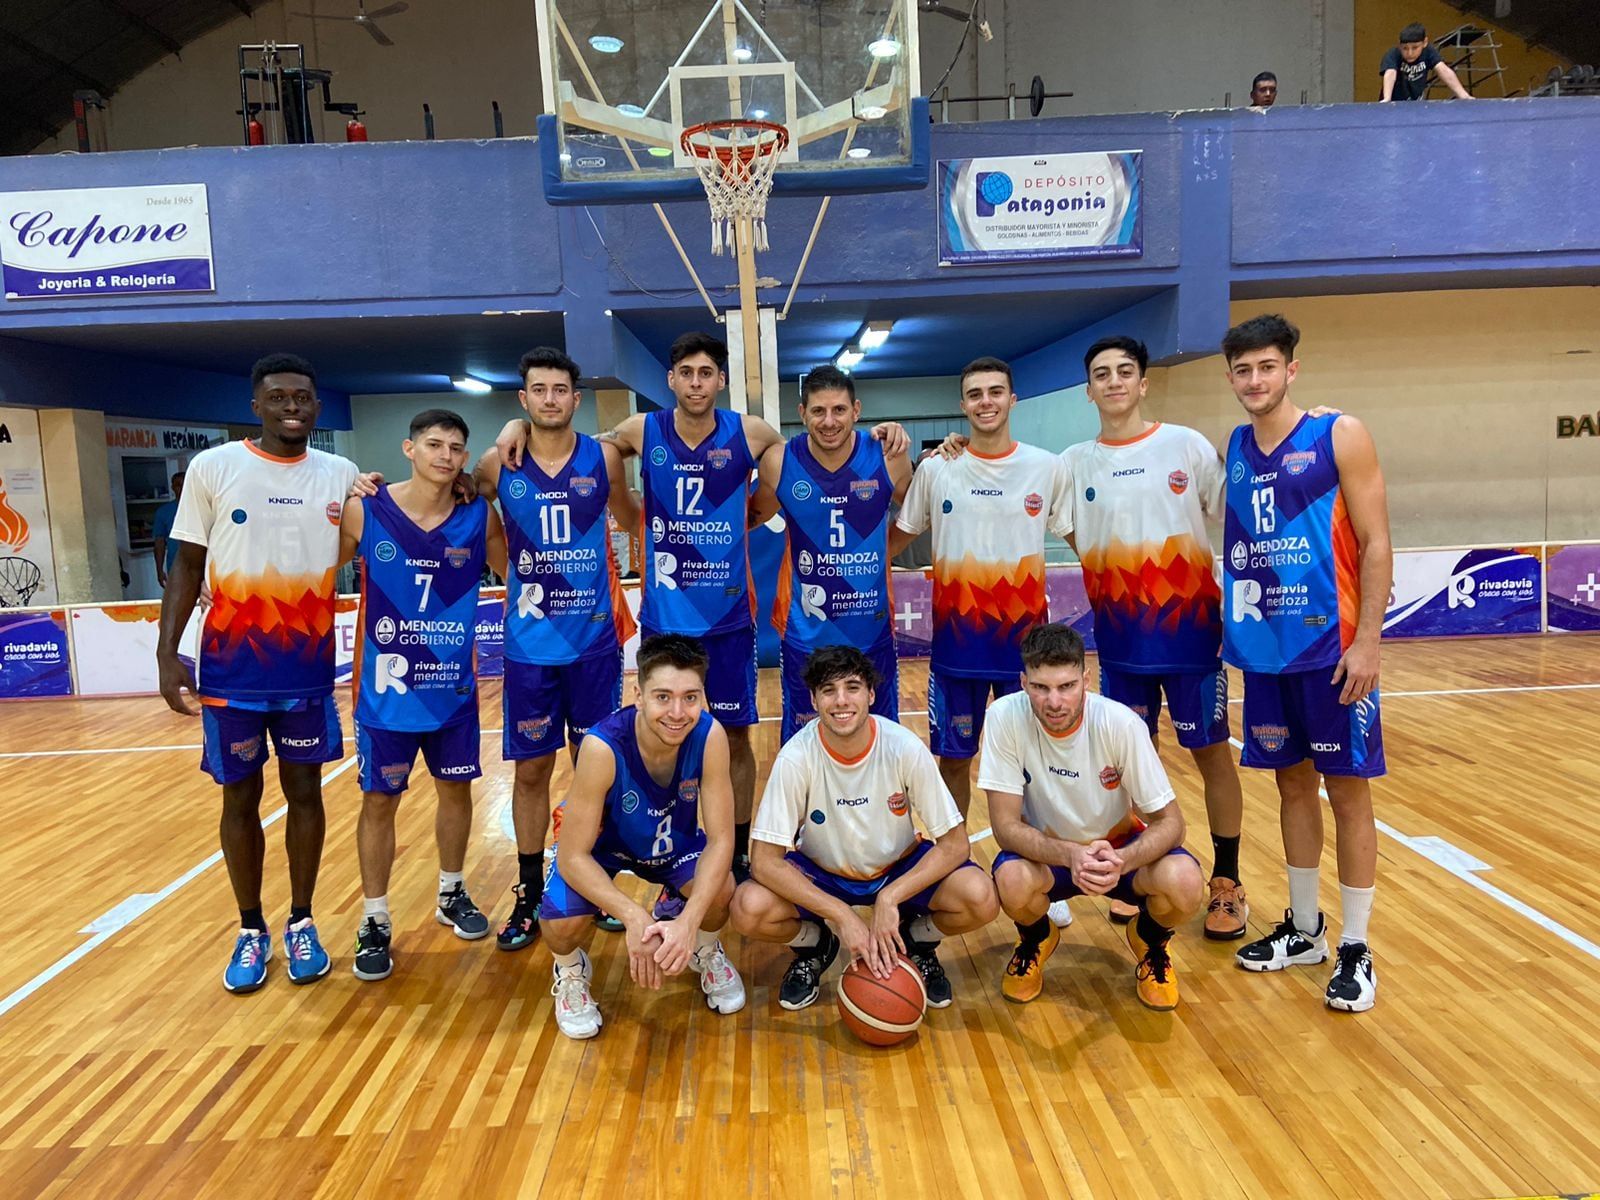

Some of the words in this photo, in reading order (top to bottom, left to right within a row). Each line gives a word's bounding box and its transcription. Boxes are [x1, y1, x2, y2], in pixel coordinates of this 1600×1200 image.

[1024, 175, 1105, 188] DEPÓSITO
[146, 197, 171, 206] Desde
[173, 196, 194, 205] 1965
[985, 224, 1026, 232] DISTRIBUIDOR
[1027, 223, 1061, 231] MAYORISTA
[1067, 221, 1099, 229] MINORISTA
[9, 210, 188, 259] Capone
[997, 232, 1028, 240] GOLOSINAS
[96, 276, 106, 287] &
[1556, 410, 1600, 439] BA
[105, 427, 157, 449] NARANJA
[673, 463, 704, 472] KNOCK
[1112, 467, 1145, 478] KNOCK
[268, 497, 303, 505] KNOCK
[535, 492, 568, 500] KNOCK
[675, 476, 705, 516] 12
[1251, 486, 1275, 534] 13
[539, 504, 571, 545] 10
[668, 521, 732, 533] MENDOZA
[830, 509, 846, 548] 5
[668, 533, 733, 545] GOBIERNO
[1250, 537, 1310, 554] MENDOZA
[535, 549, 597, 562] MENDOZA
[817, 551, 879, 565] MENDOZA
[1250, 552, 1311, 568] GOBIERNO
[405, 558, 440, 568] KNOCK
[535, 561, 598, 574] GOBIERNO
[682, 560, 730, 569] rivadavia
[682, 570, 730, 579] mendoza
[817, 563, 879, 577] GOBIERNO
[1479, 578, 1532, 590] rivadavia
[415, 573, 434, 613] 7
[550, 587, 596, 598] rivadavia
[832, 589, 878, 600] rivadavia
[550, 597, 596, 608] mendoza
[832, 599, 878, 610] mendoza
[399, 620, 465, 633] MENDOZA
[399, 634, 465, 646] GOBIERNO
[4, 641, 58, 653] rivadavia
[414, 661, 460, 671] rivadavia
[281, 736, 319, 747] KNOCK
[440, 763, 476, 775] KNOCK
[1049, 766, 1079, 778] KNOCK
[837, 797, 869, 807] KNOCK
[652, 814, 674, 857] 8
